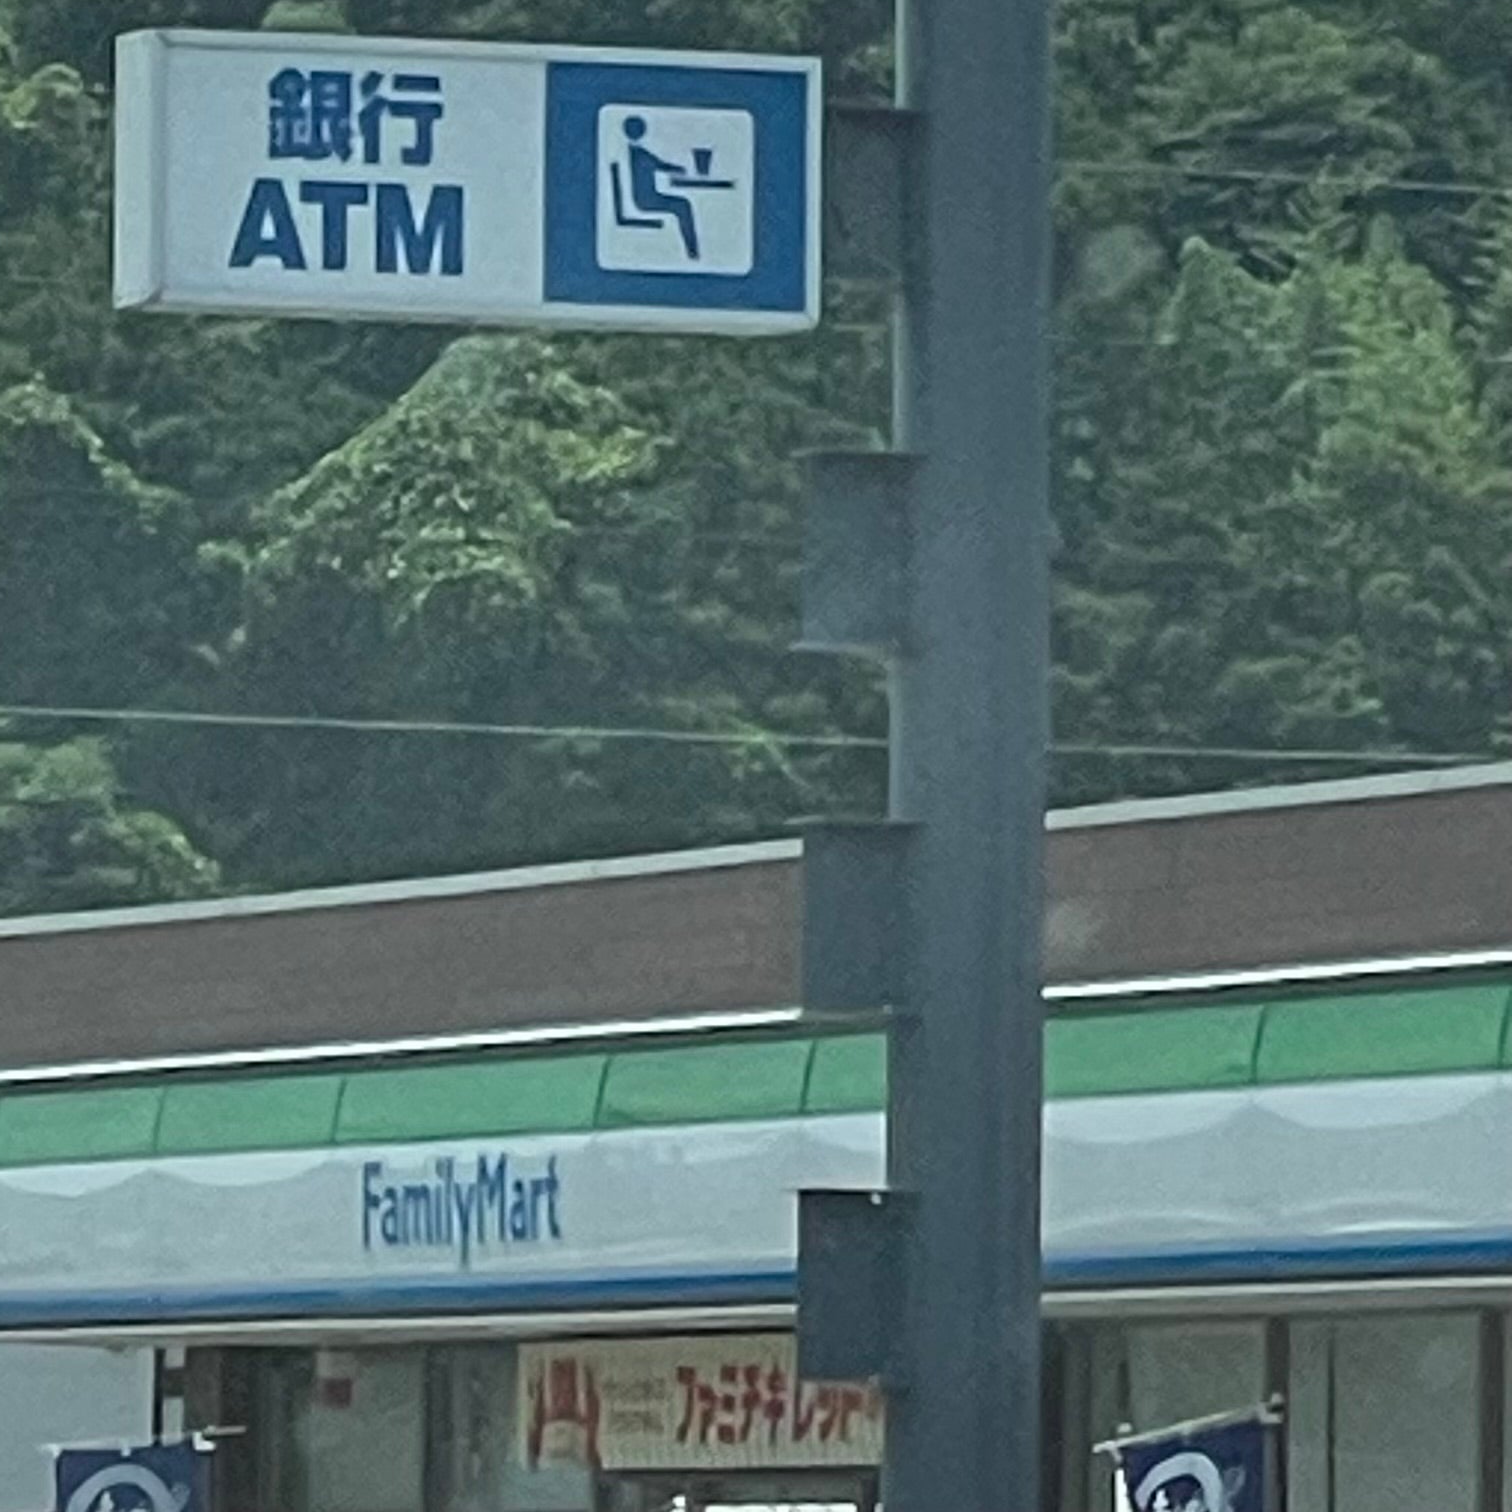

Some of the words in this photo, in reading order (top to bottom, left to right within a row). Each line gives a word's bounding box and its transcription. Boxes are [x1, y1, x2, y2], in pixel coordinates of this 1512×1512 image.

[268, 66, 445, 167] 銀行
[228, 177, 465, 277] ATM
[363, 1152, 561, 1266] FamilyMart
